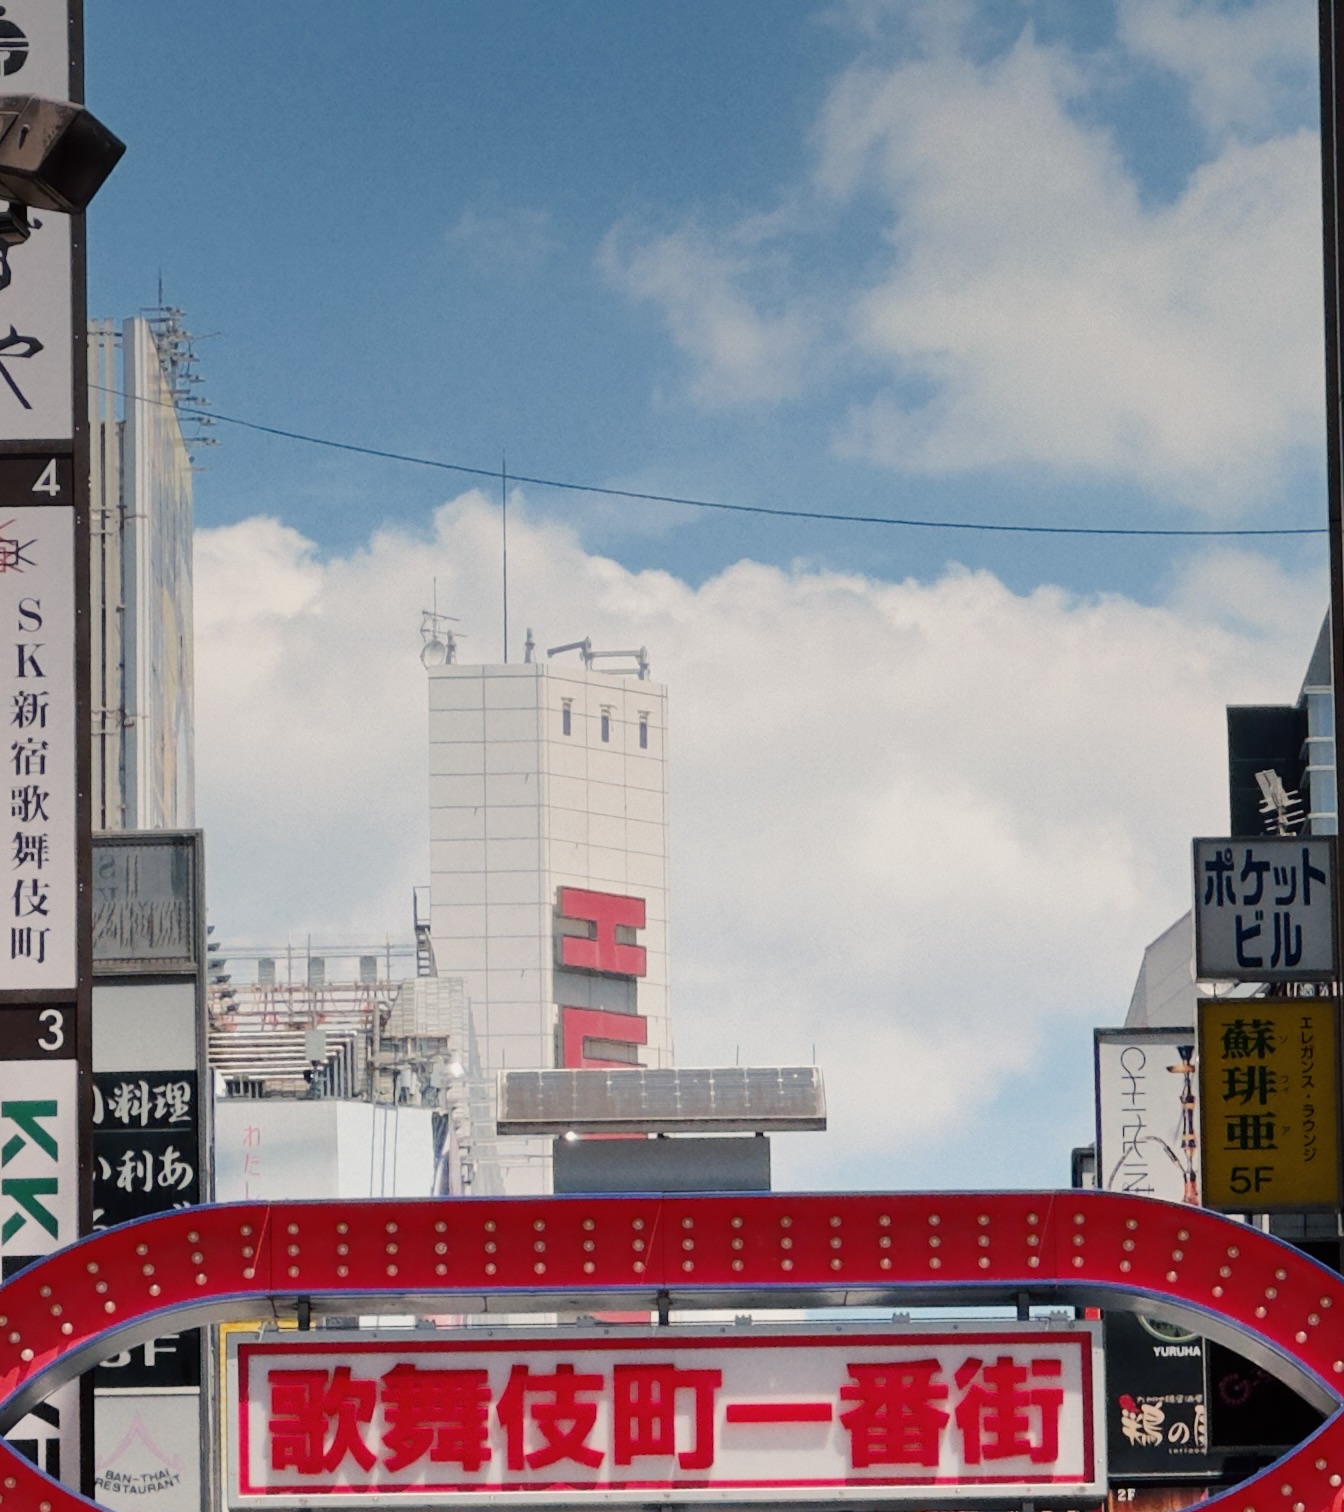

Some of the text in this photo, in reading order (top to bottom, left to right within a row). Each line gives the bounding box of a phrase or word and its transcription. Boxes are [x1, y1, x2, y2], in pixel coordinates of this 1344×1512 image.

[32, 459, 60, 496] 4
[9, 597, 51, 964] SK新宿歌舞伎町
[1204, 849, 1327, 907] ポケット
[1235, 912, 1302, 969] ビル
[37, 1009, 64, 1051] 3
[1229, 1165, 1276, 1194] 5F
[1153, 1346, 1201, 1357] YURUHA
[267, 1358, 1065, 1472] 歌舞伎町一番街
[105, 1469, 171, 1484] BAN-THAI
[1117, 1489, 1136, 1501] 2F
